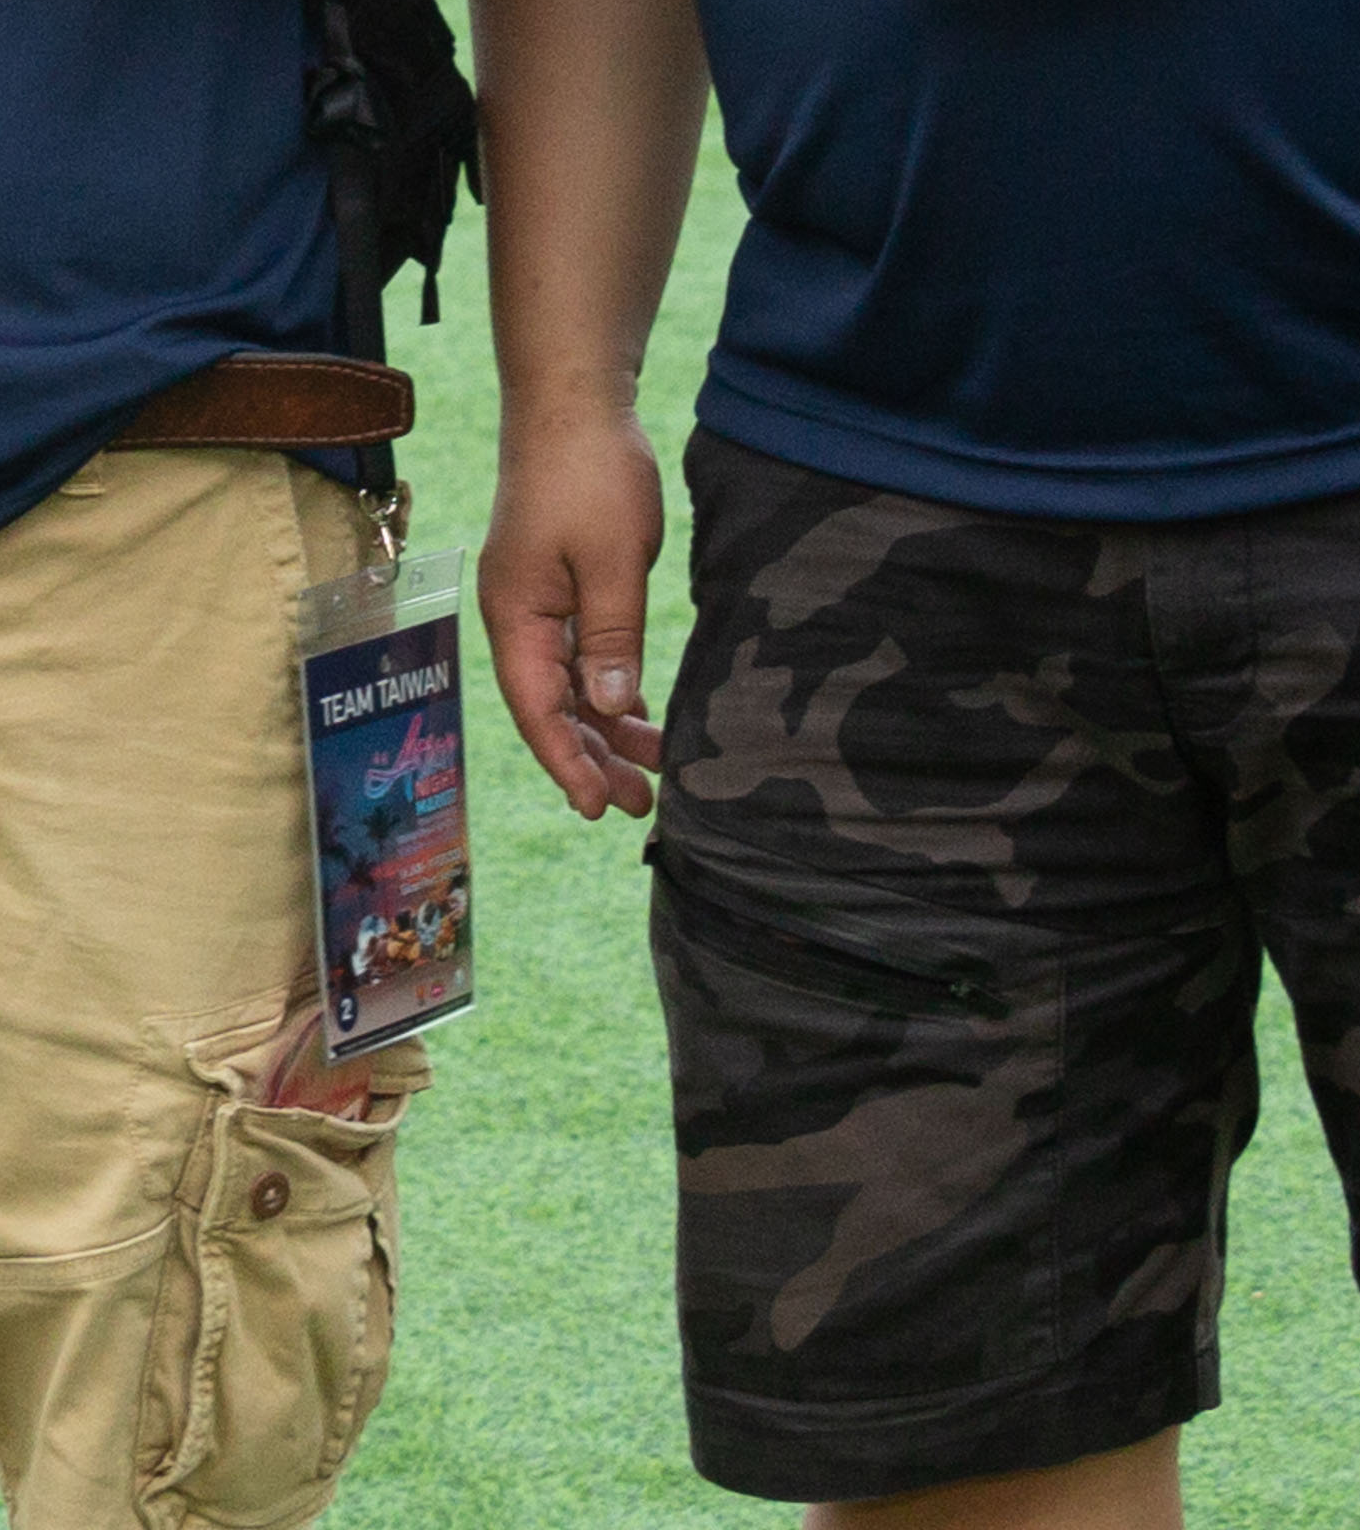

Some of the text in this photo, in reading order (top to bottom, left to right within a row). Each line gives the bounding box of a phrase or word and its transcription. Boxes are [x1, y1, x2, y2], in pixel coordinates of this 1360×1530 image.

[319, 660, 450, 726] TEAM TAIWAN
[340, 997, 354, 1021] 2
